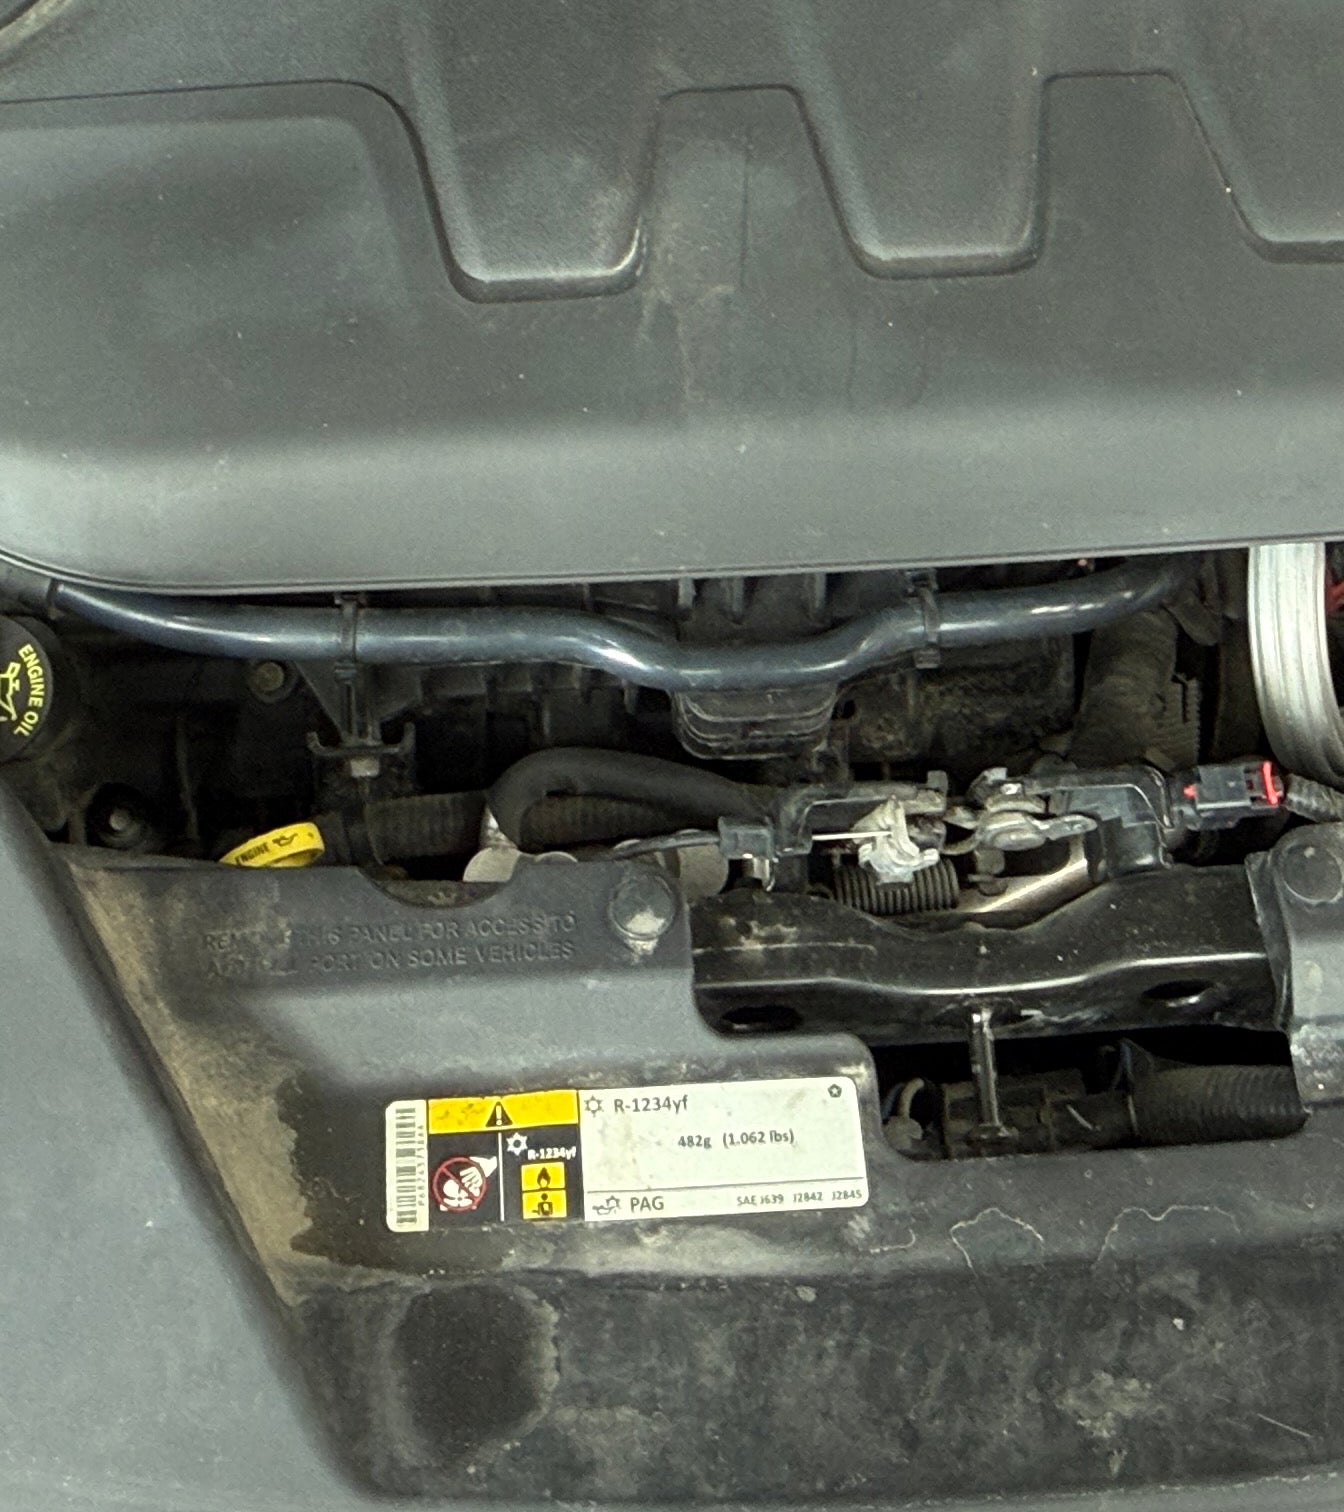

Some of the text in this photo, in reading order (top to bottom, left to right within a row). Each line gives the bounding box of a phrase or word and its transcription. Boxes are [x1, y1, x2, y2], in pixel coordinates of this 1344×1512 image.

[12, 642, 46, 737] ENGINE OIL
[465, 914, 545, 938] ACCESS
[370, 949, 403, 969] ON
[408, 946, 468, 968] SOME
[474, 938, 577, 963] VEHICLES
[613, 1094, 688, 1116] R-1234yf
[678, 1128, 796, 1150] 482g (1.062 lbs)
[527, 1146, 577, 1161] R-1234yf
[630, 1195, 665, 1213] PAG
[736, 1194, 757, 1207] SAE
[760, 1193, 785, 1205] J639
